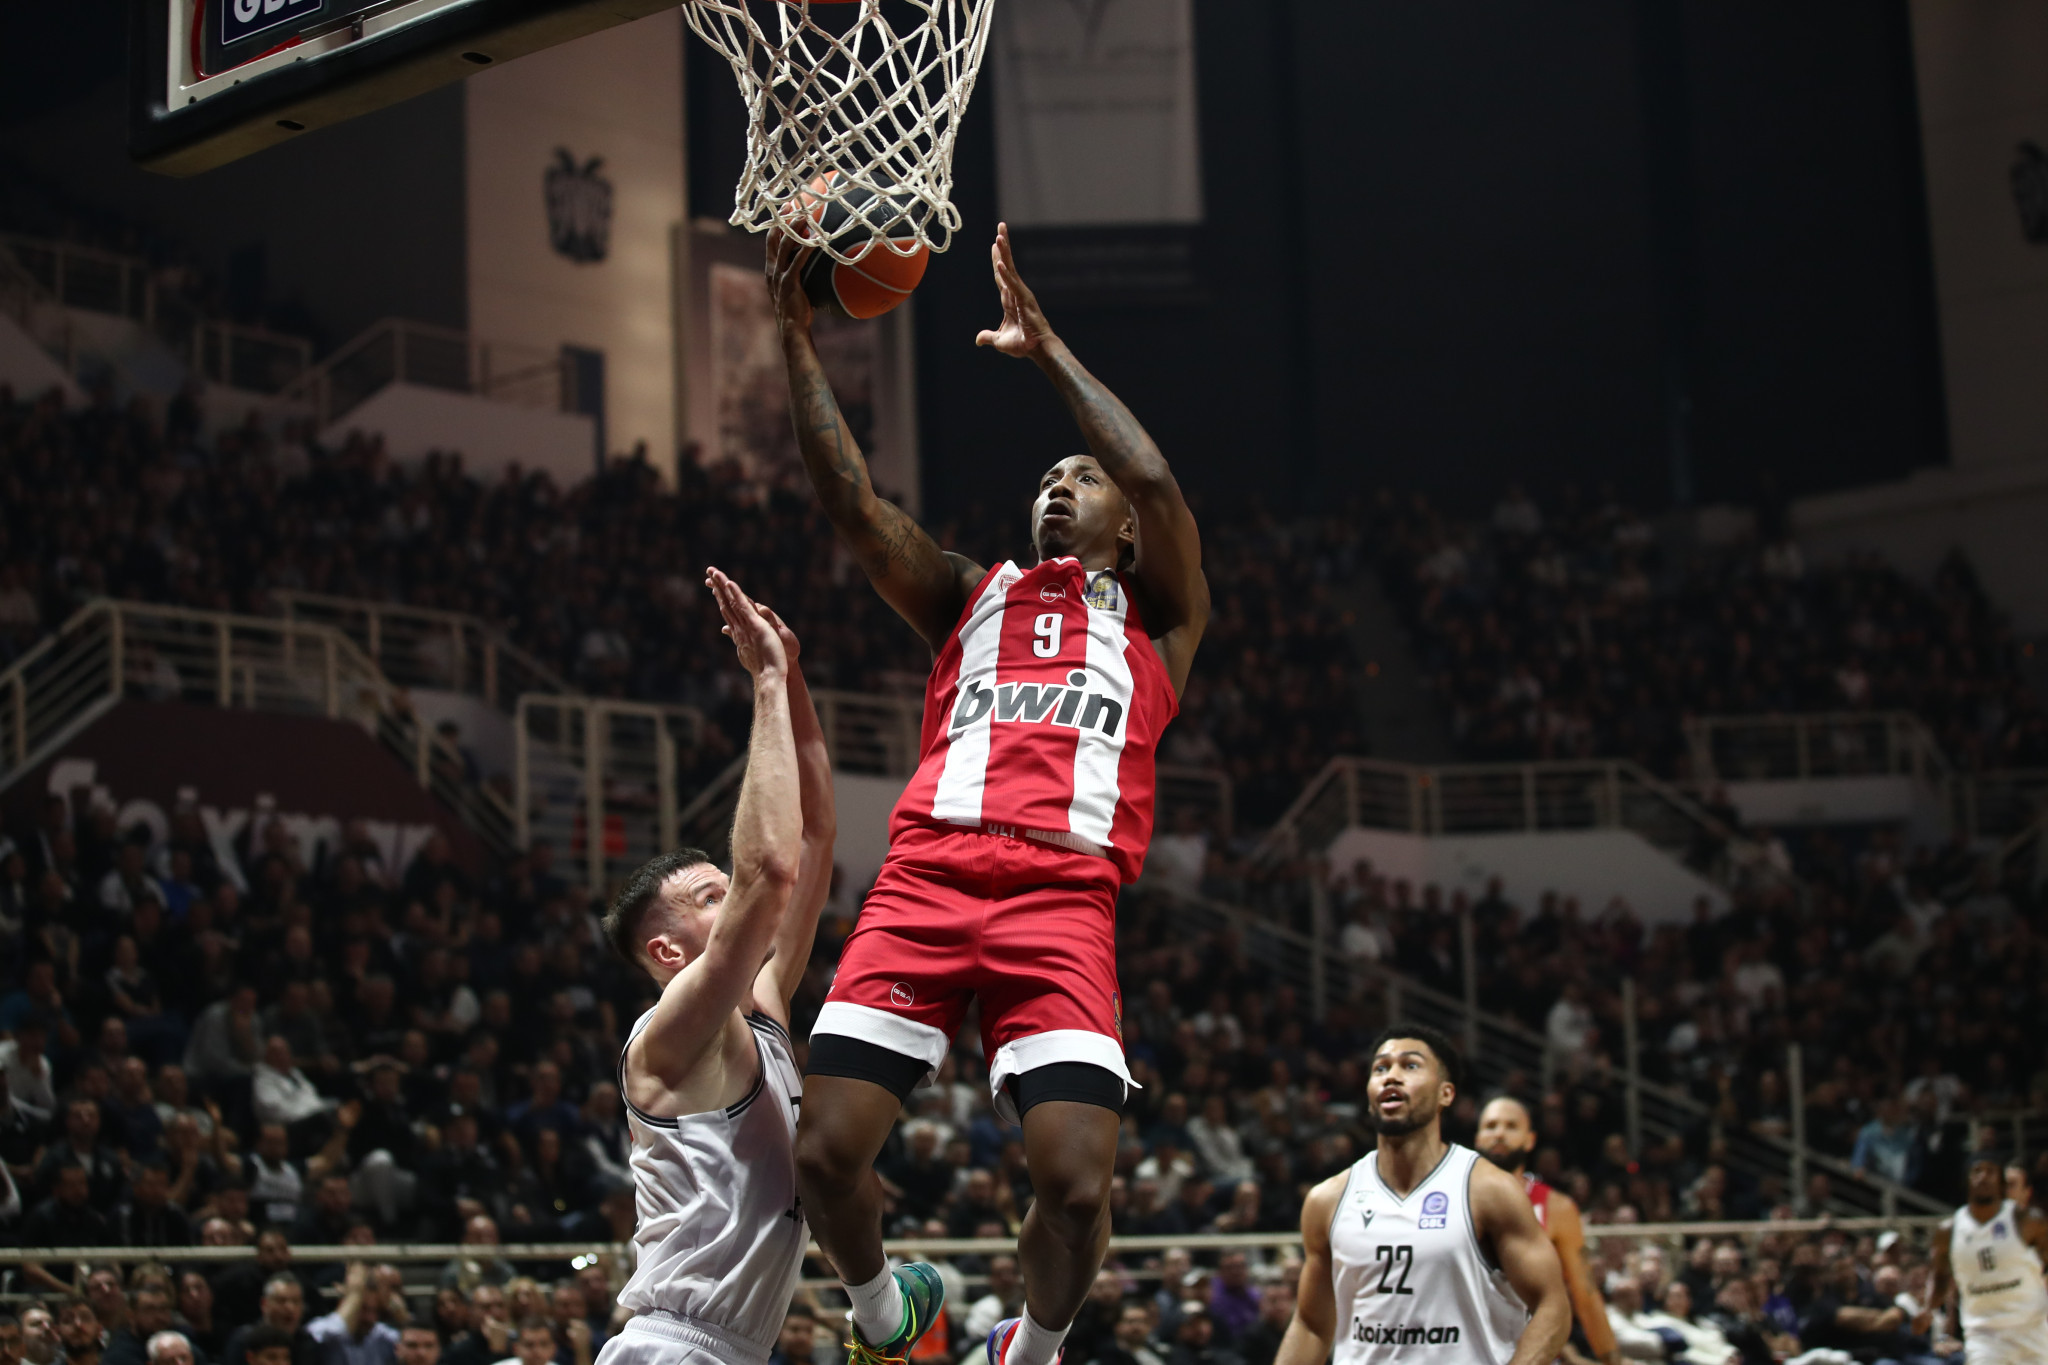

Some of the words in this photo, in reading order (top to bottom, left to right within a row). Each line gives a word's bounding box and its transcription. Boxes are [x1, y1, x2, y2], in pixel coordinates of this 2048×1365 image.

[1033, 613, 1063, 658] 9
[950, 669, 1124, 738] bwin
[1420, 1218, 1445, 1228] GBL
[1376, 1245, 1413, 1294] 22
